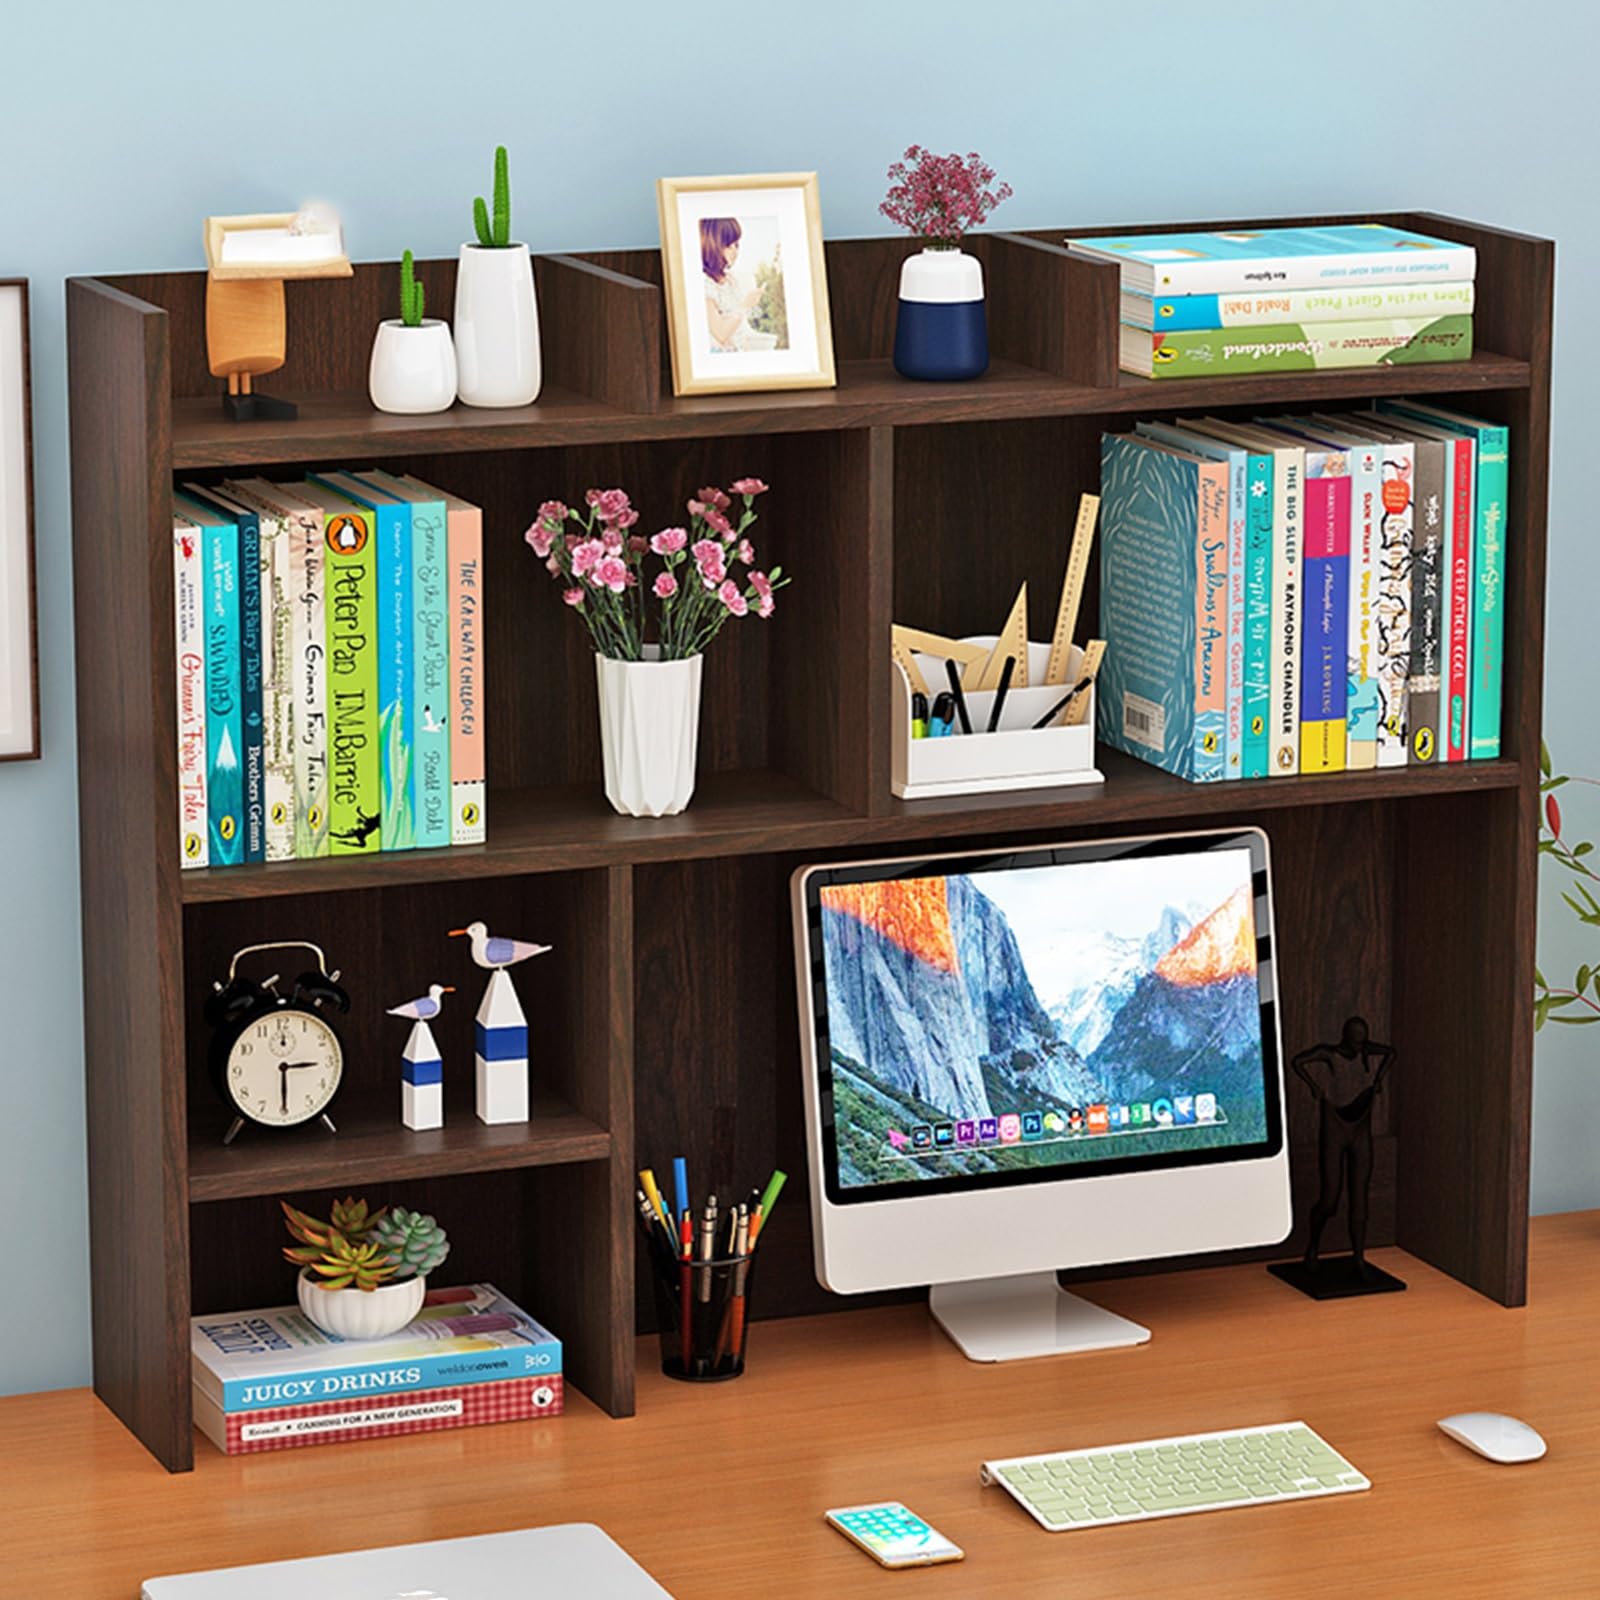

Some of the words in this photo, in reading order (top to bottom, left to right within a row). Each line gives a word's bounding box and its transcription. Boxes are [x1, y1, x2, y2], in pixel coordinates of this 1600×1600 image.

[1224, 302, 1251, 314] Dahl
[1257, 299, 1290, 314] Roald
[1306, 298, 1342, 310] Peach
[1348, 295, 1382, 308] Giant
[1388, 294, 1405, 303] the
[1408, 292, 1428, 303] and
[1434, 288, 1470, 303] James
[1223, 338, 1324, 360] Wonderland
[1287, 465, 1296, 490] THE
[1287, 496, 1296, 520] BIG
[414, 516, 443, 561] James
[1232, 520, 1244, 566] James
[1286, 526, 1296, 564] SLEEP
[1326, 522, 1334, 552] POTTER
[244, 527, 259, 606] GRIMM'S
[461, 560, 476, 587] THE
[1202, 537, 1226, 611] Swallows
[332, 563, 366, 630] Peter
[1232, 574, 1244, 605] and
[1453, 557, 1467, 641] OPERATION
[244, 611, 258, 650] Fairy
[417, 611, 444, 651] Giant
[460, 595, 476, 662] RAILWAY
[1232, 611, 1243, 635] the
[1284, 583, 1296, 656] RAYMOND
[333, 632, 366, 674] Pan
[1200, 627, 1222, 695] Amazons
[1231, 642, 1242, 688] Giant
[1453, 646, 1464, 681] COOL
[247, 654, 260, 692] Tales
[422, 653, 446, 695] Peach
[1245, 661, 1269, 703] Wind
[1323, 665, 1332, 713] ROWLING
[459, 666, 474, 735] CHILDREN
[1282, 662, 1293, 734] CHANDLER
[303, 712, 324, 744] Fairy
[1230, 696, 1241, 741] Peach
[248, 746, 260, 802] Brothers
[307, 752, 325, 791] Tales
[424, 751, 440, 791] Roald
[250, 804, 261, 852] Grimm
[425, 797, 443, 833] Dahl
[257, 1025, 267, 1038] 11
[276, 1017, 289, 1030] 12
[302, 1021, 307, 1032] 1
[240, 1043, 253, 1055] 10
[318, 1034, 326, 1047] 2
[233, 1065, 242, 1079] 9
[325, 1055, 334, 1068] 3
[240, 1086, 250, 1099] 8
[319, 1077, 327, 1089] 4
[258, 1100, 267, 1113] 7
[305, 1094, 313, 1107] 5
[961, 1126, 971, 1137] Pr
[1026, 1119, 1038, 1130] Ps
[242, 1379, 316, 1403] JUICY
[322, 1367, 421, 1394] DRINKS
[297, 1418, 341, 1430] CANNING
[343, 1416, 362, 1424] FOR
[374, 1411, 395, 1420] NEW
[397, 1403, 457, 1418] GENERATION
